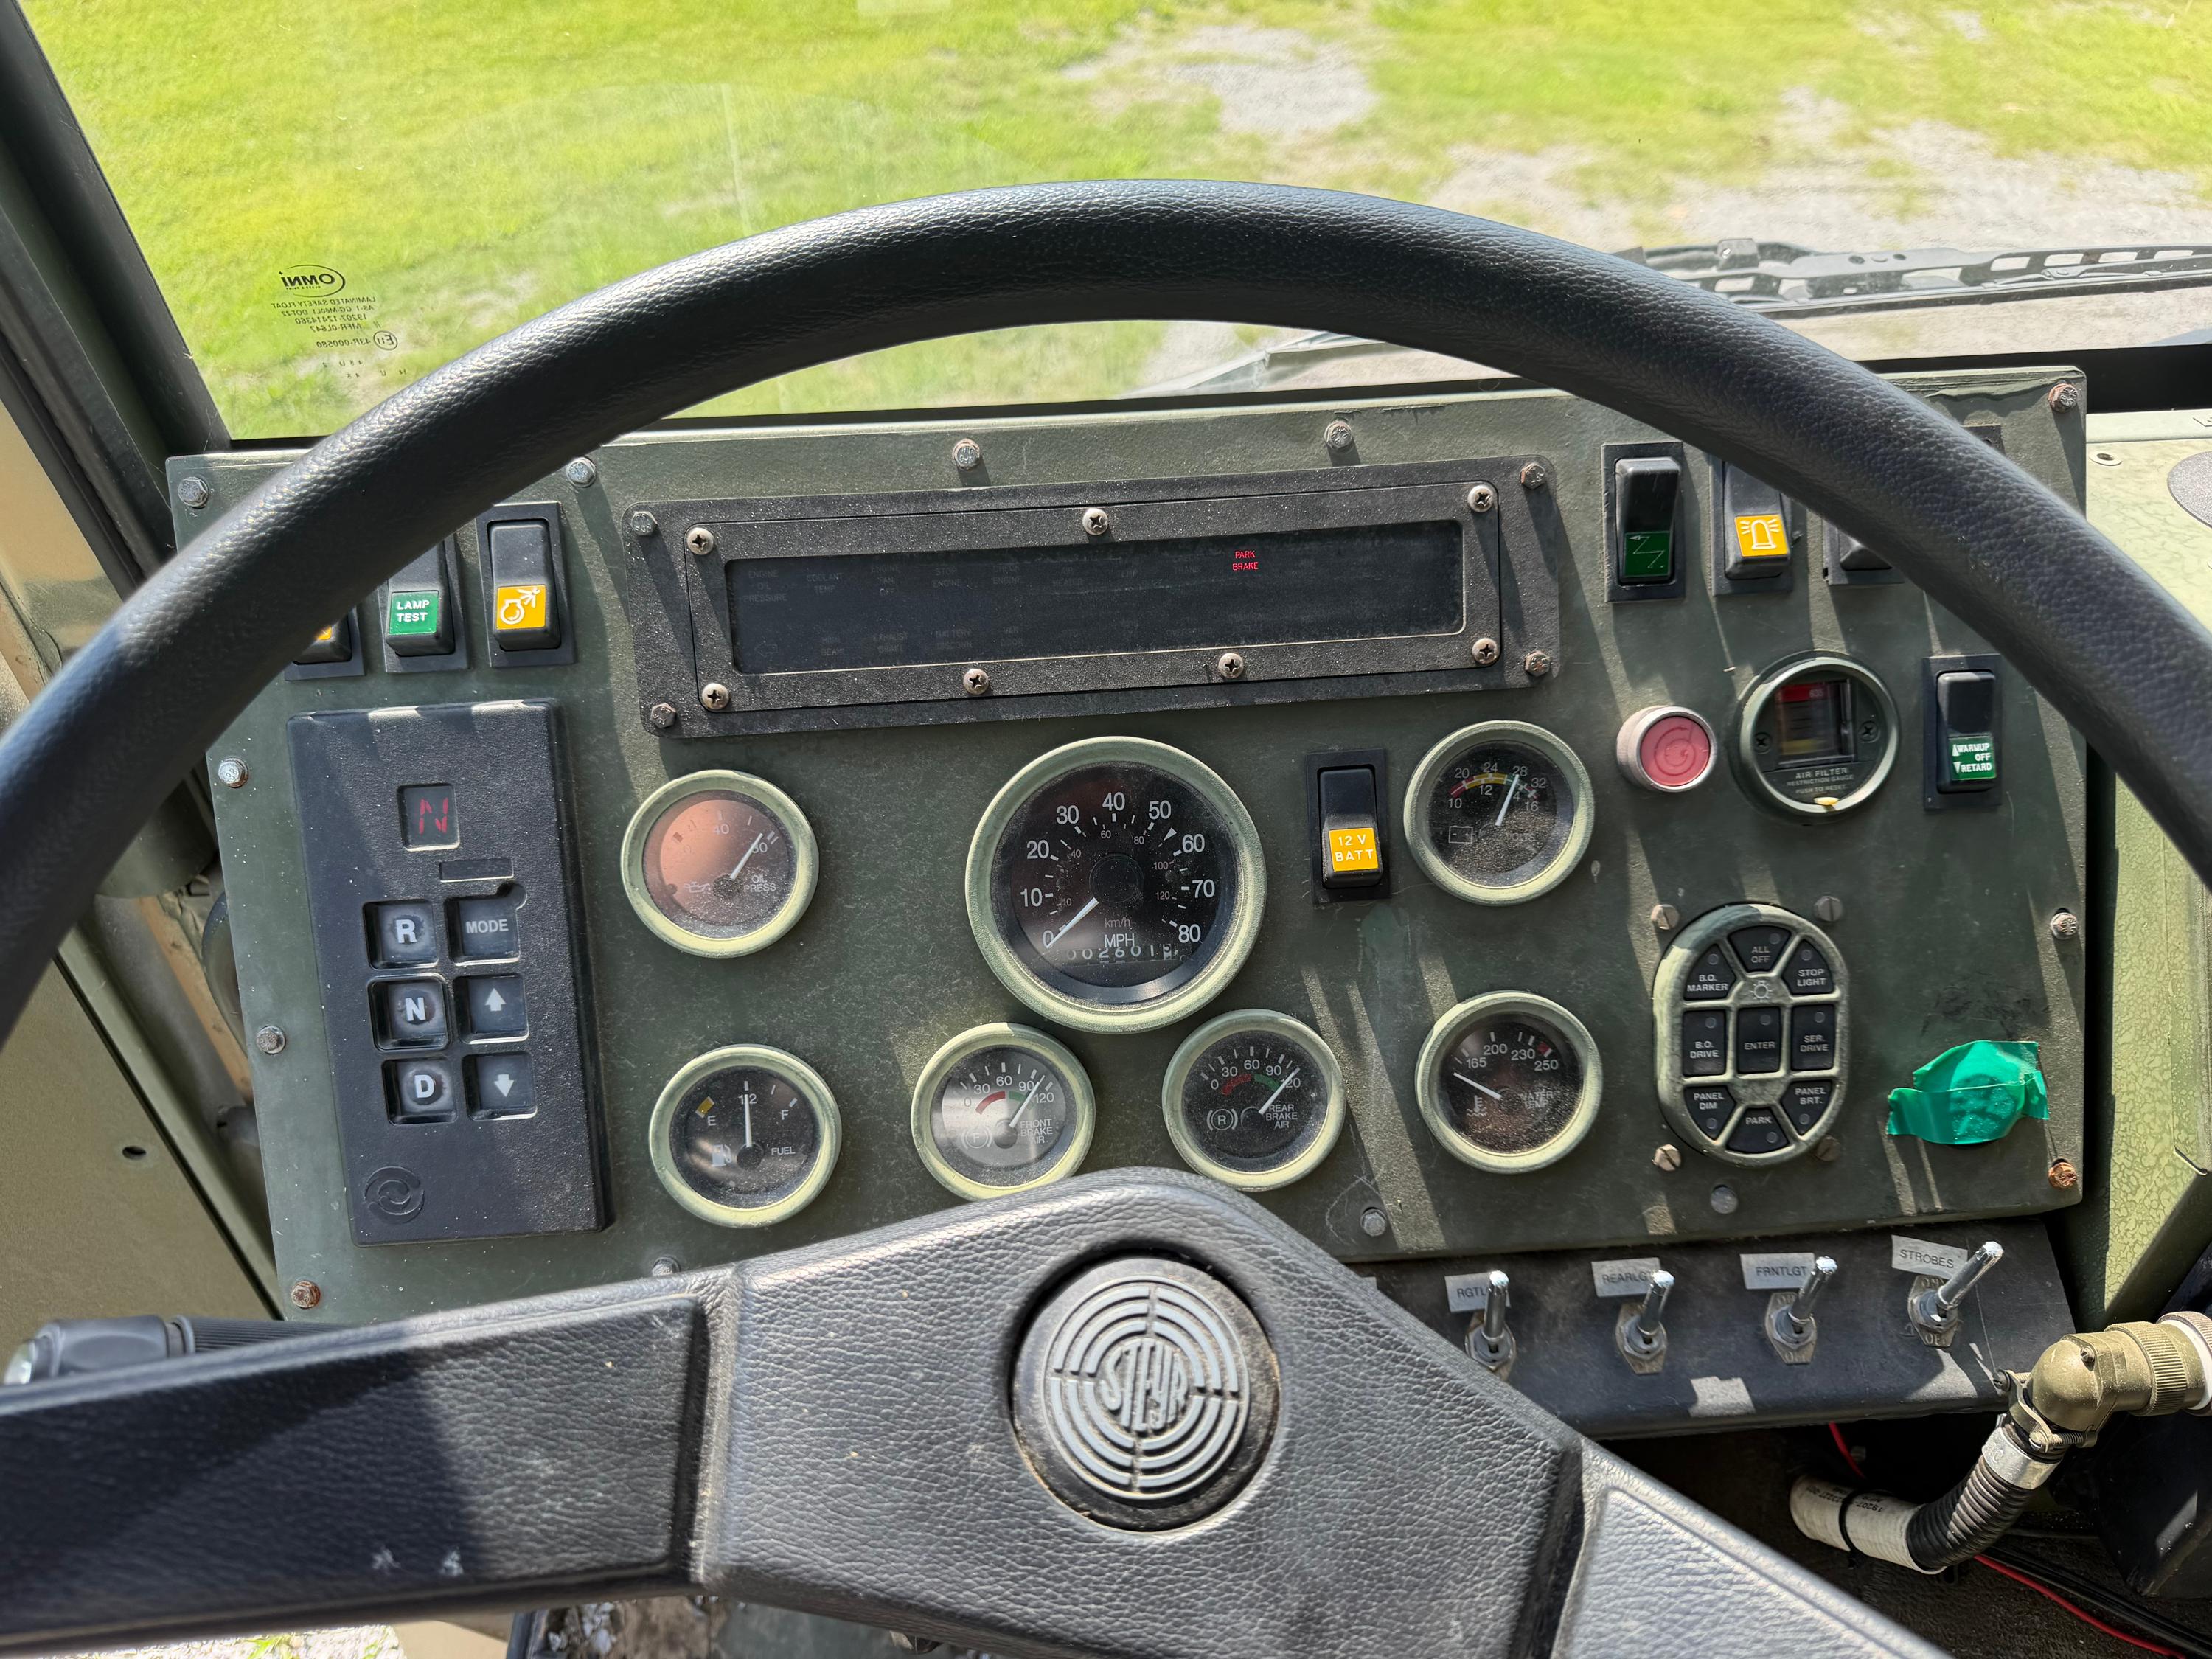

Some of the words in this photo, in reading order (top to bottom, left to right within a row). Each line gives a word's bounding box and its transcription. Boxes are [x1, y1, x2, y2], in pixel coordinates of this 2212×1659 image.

[1235, 551, 1256, 559] PARK
[1232, 562, 1259, 571] BRAKE
[396, 599, 430, 611] LAMP
[396, 611, 428, 623] TEST
[1957, 742, 1990, 753] WARMUP
[1975, 752, 1991, 761] OFF
[1483, 762, 1498, 773] 24
[1512, 765, 1528, 777] 28
[1795, 771, 1812, 779] AIR
[1815, 767, 1848, 777] FILTER
[1961, 762, 1992, 773] RETARD
[1454, 768, 1470, 779] 20
[1531, 778, 1547, 789] 32
[1479, 785, 1493, 796] 12
[1102, 791, 1126, 811] 40
[1448, 798, 1463, 809] 10
[1524, 801, 1540, 812] 16
[1056, 805, 1079, 825] 30
[1148, 800, 1172, 820] 50
[418, 797, 449, 835] N
[714, 823, 730, 835] 40
[1100, 830, 1111, 839] 60
[1133, 835, 1144, 845] 80
[1182, 833, 1206, 853] 60
[1337, 835, 1351, 846] 12
[1357, 834, 1367, 845] V
[1027, 839, 1050, 859] 20
[1071, 849, 1082, 858] 40
[1335, 848, 1374, 862] BATT
[1154, 860, 1169, 870] 100
[751, 874, 768, 884] OIL
[743, 883, 776, 893] PRESS
[1192, 879, 1215, 898] 70
[1020, 888, 1043, 907] 10
[1155, 890, 1170, 900] 120
[466, 918, 509, 934] MODE
[1105, 917, 1131, 928] km/h
[396, 919, 418, 945] R
[1178, 923, 1201, 944] 80
[1105, 932, 1135, 948] MPH
[1751, 946, 1770, 954] ALL
[1751, 954, 1770, 964] OFF
[1698, 973, 1717, 982] B.O.
[1797, 968, 1825, 978] STOP
[1687, 983, 1728, 992] MARKER
[1797, 977, 1826, 987] LIGHT
[404, 997, 427, 1023] N
[1803, 1034, 1826, 1043] SER.
[1483, 1043, 1508, 1056] 200
[1694, 1040, 1714, 1049] B.O.
[1744, 1041, 1775, 1051] ENTER
[1800, 1043, 1829, 1053] DRIVE
[1511, 1048, 1536, 1060] 230
[1689, 1049, 1719, 1059] DRIVE
[1243, 1059, 1260, 1071] 60
[1466, 1057, 1487, 1069] 165
[1534, 1059, 1559, 1072] 250
[1221, 1066, 1238, 1077] 30
[1266, 1065, 1282, 1077] 90
[414, 1074, 436, 1099] D
[996, 1075, 1013, 1087] 60
[1018, 1079, 1035, 1092] 90
[1211, 1079, 1220, 1091] 0
[973, 1083, 990, 1095] 30
[1795, 1087, 1826, 1096] PANEL
[1034, 1091, 1055, 1104] 120
[1518, 1091, 1554, 1100] WATER
[1693, 1091, 1725, 1101] PANEL
[1799, 1096, 1823, 1105] BRT.
[964, 1096, 972, 1107] 0
[1699, 1101, 1717, 1110] DIM
[1268, 1104, 1295, 1113] REAR
[781, 1109, 789, 1121] F
[1217, 1114, 1226, 1125] R
[1265, 1111, 1298, 1121] BRAKE
[1745, 1116, 1772, 1124] PARK
[707, 1115, 717, 1127] E
[1020, 1118, 1053, 1129] FRONT
[1274, 1120, 1290, 1129] AIR
[1020, 1126, 1054, 1137] BRAKE
[771, 1146, 796, 1156] FUEL
[1899, 1248, 1955, 1269] STROBES
[1756, 1266, 1806, 1277] FRNTLGT
